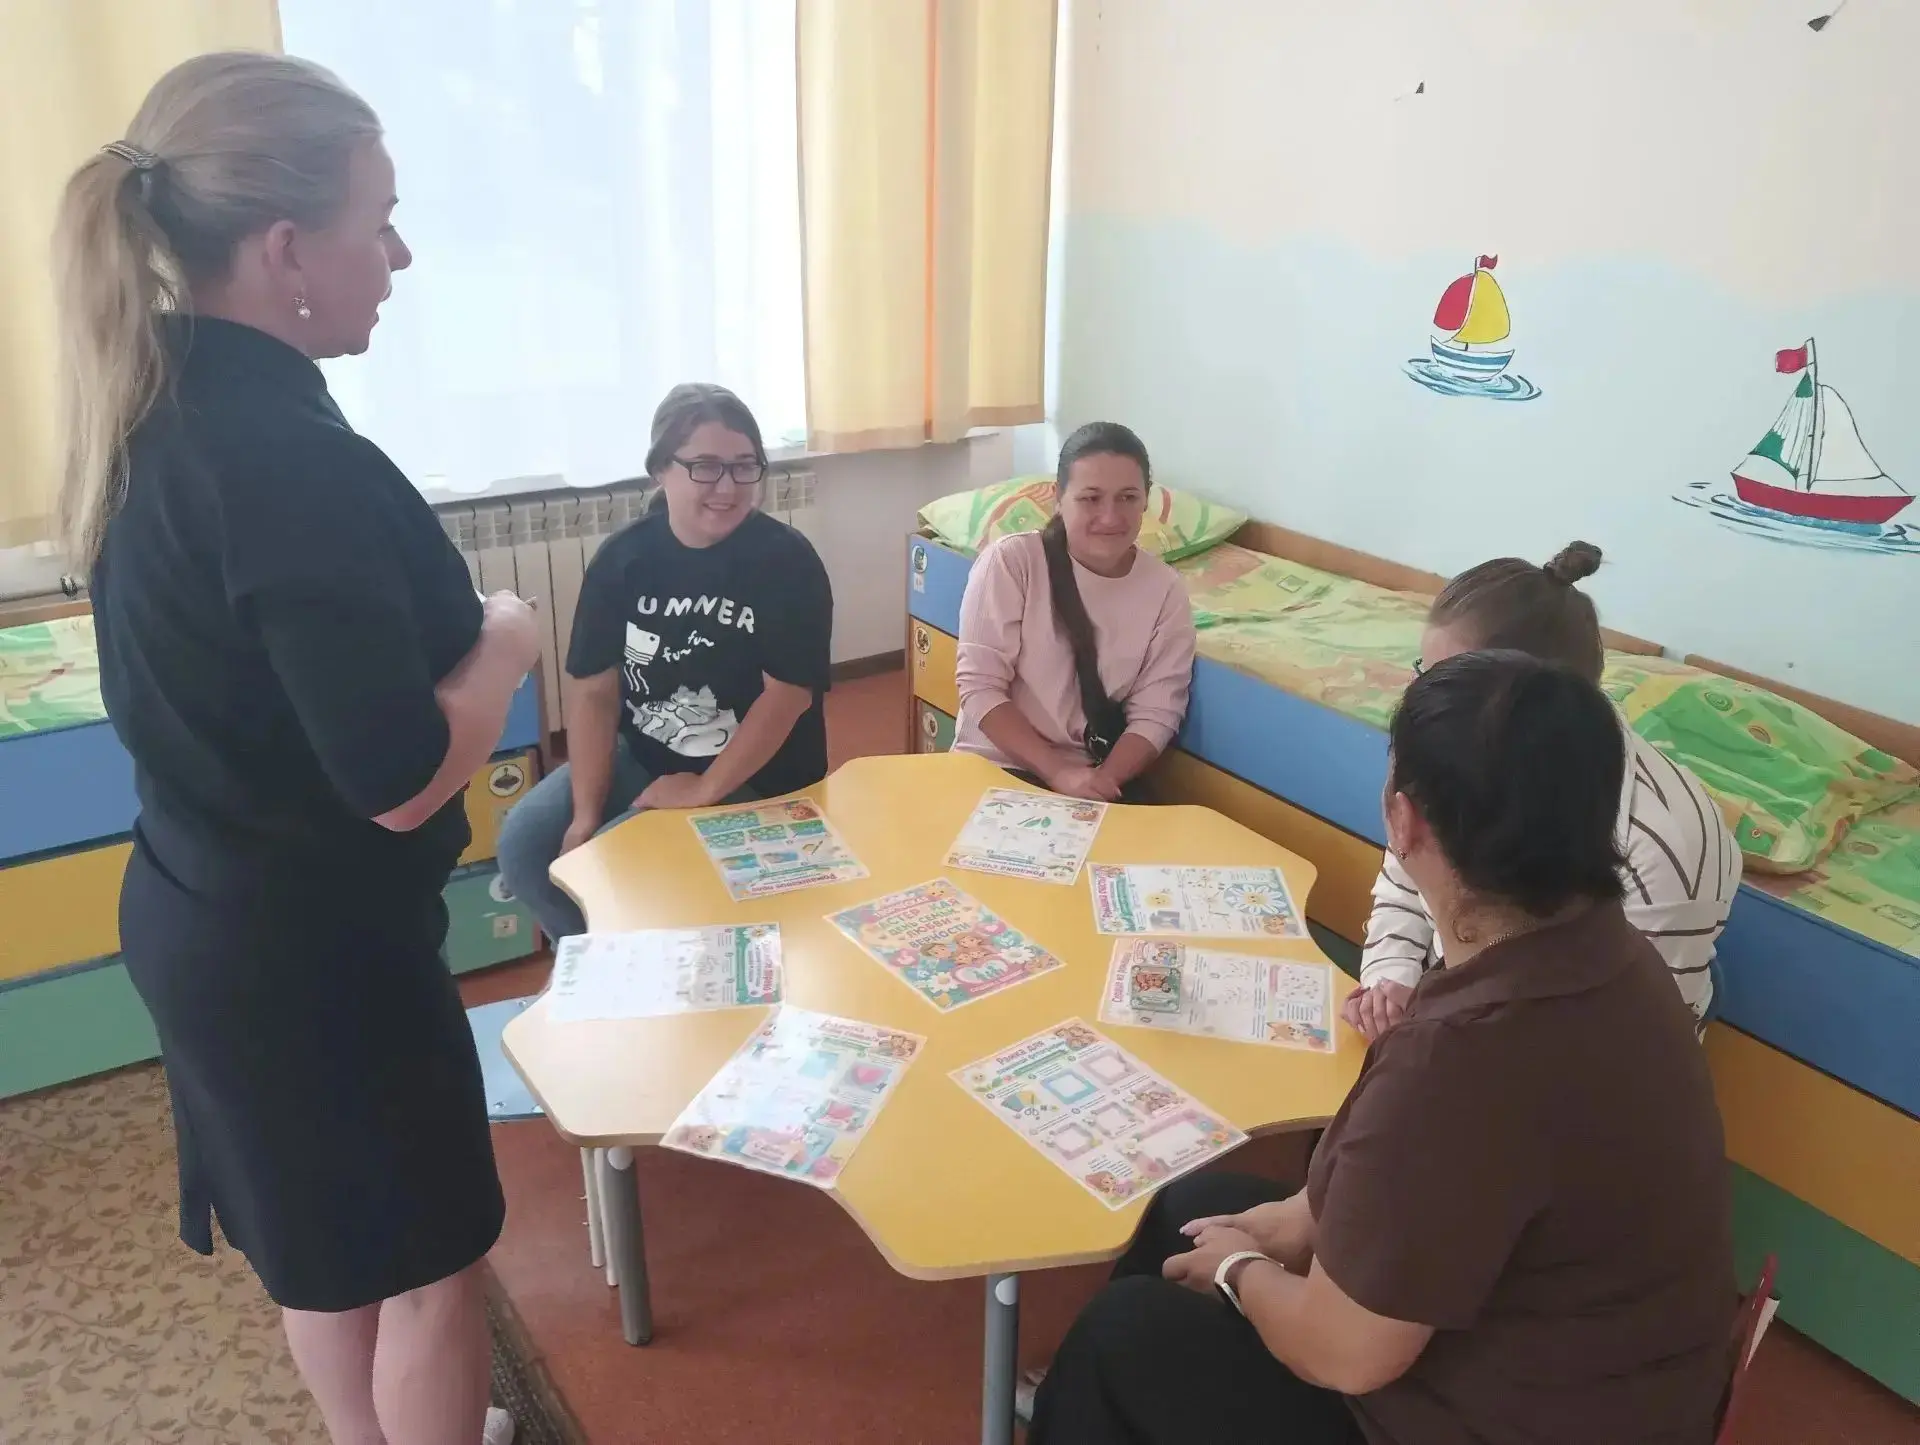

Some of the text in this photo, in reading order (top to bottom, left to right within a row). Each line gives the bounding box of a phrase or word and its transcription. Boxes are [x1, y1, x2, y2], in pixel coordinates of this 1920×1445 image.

[662, 646, 692, 663] fun
[906, 917, 952, 938] ЛЮБВИ
[909, 921, 971, 948] ВЕРНОСТИ
